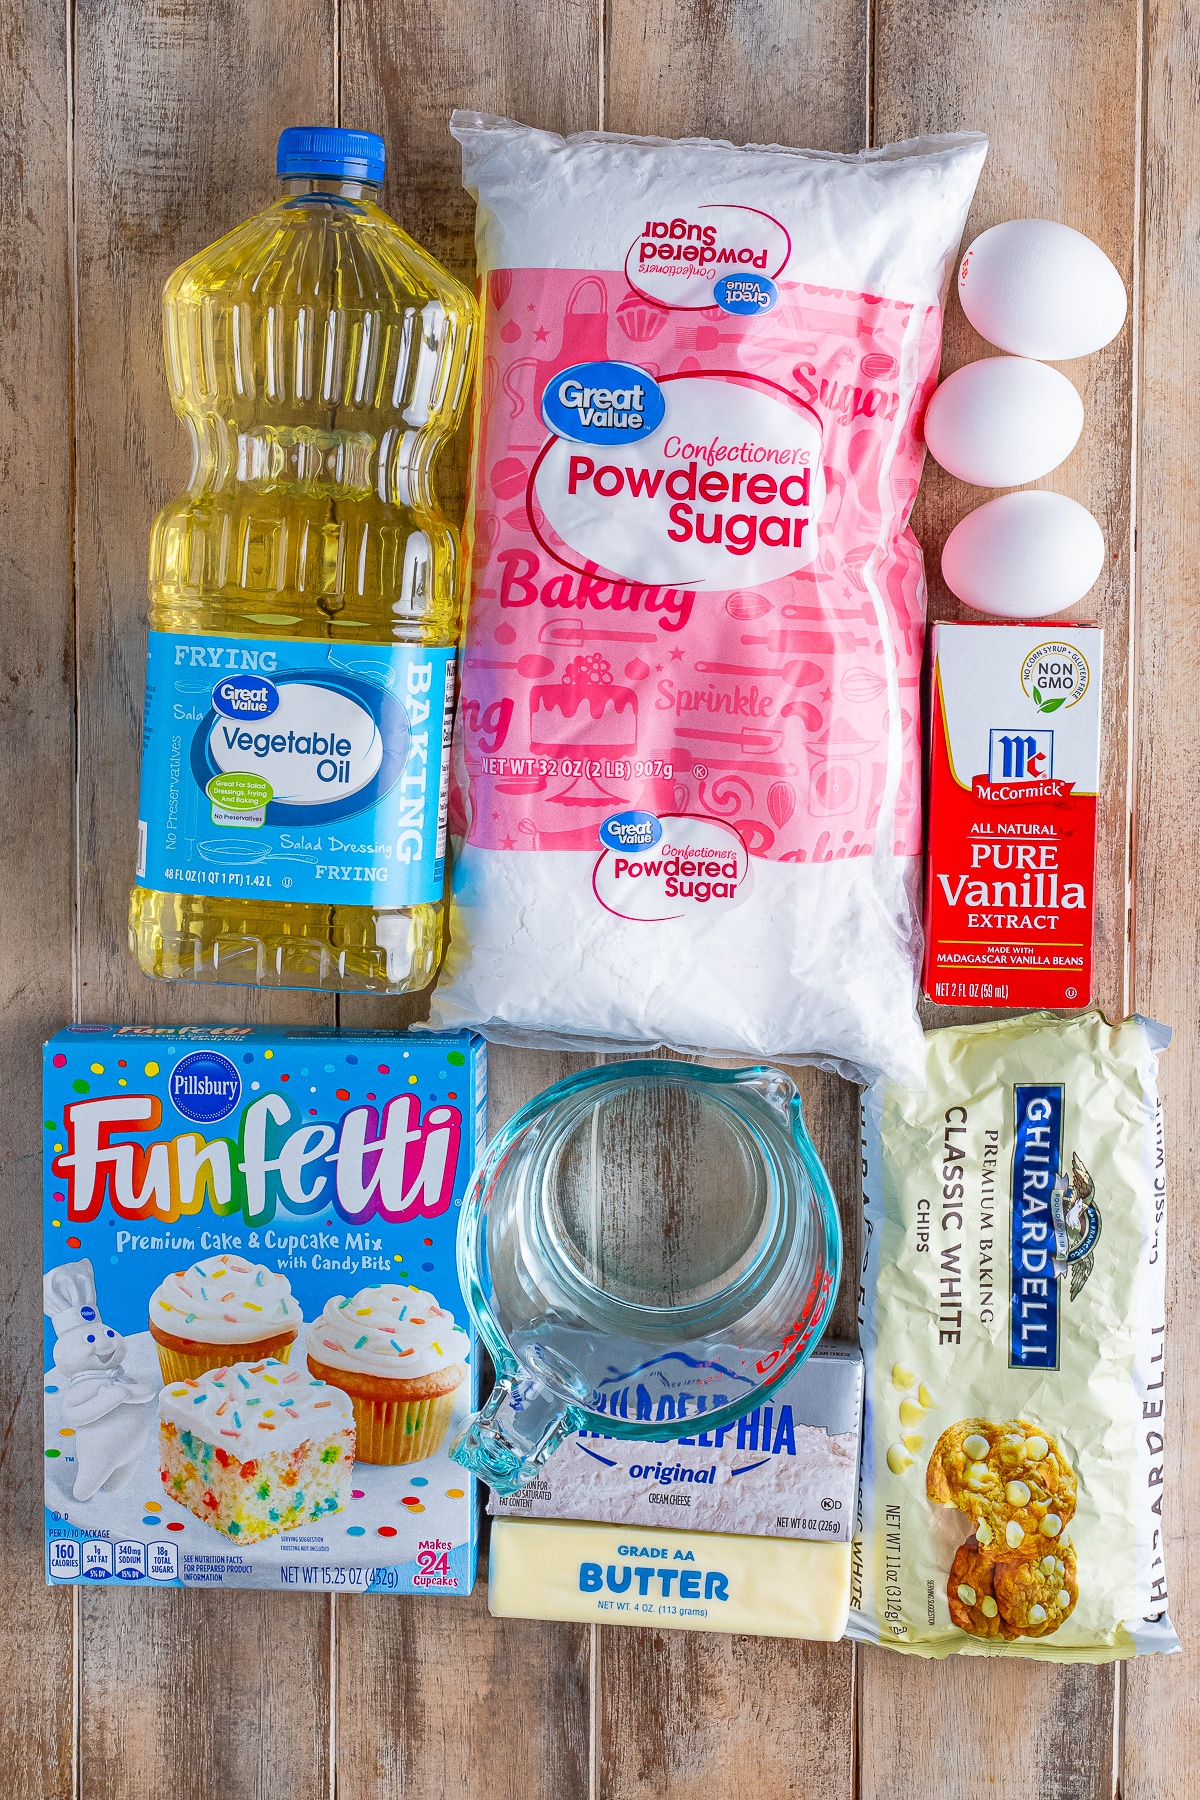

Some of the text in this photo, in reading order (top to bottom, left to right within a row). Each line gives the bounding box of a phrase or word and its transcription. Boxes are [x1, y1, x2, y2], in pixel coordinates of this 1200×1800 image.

[642, 218, 717, 246] Sugar
[640, 242, 768, 269] Powdered
[638, 264, 716, 280] Confectioners
[726, 281, 760, 293] Value
[725, 289, 771, 308] Great
[558, 379, 645, 412] Great
[787, 362, 899, 426] Sugar
[578, 406, 643, 429] Value
[663, 436, 810, 466] Confectioners
[568, 455, 810, 507] Powdered
[667, 502, 809, 556] Sugar
[497, 549, 696, 632] Baking
[174, 644, 277, 672] FRYING
[1024, 645, 1067, 680] NO CORN SYRUP
[1038, 663, 1072, 675] NON
[1071, 653, 1086, 700] GLUTEN FREE
[1037, 676, 1073, 689] GMO
[220, 684, 268, 702] Great
[655, 679, 776, 718] Sprinkle
[231, 699, 268, 712] Value
[222, 727, 351, 757] Vegetable
[317, 760, 351, 783] Oil
[397, 661, 432, 864] BAKING
[481, 757, 673, 781] NET WT 32 OZ (2 LB) 907g
[166, 735, 181, 850] No Preservatives
[236, 797, 258, 805] Baking
[247, 790, 267, 798] Frying
[976, 782, 1063, 801] McCormick
[607, 820, 652, 836] Great
[970, 823, 1057, 836] ALL NATURAL
[280, 833, 393, 858] Salad Dressing
[619, 833, 652, 845] Value
[661, 844, 737, 859] Confectioners
[970, 843, 1059, 871] PURE
[164, 868, 271, 887] 48 FL OZ (1 QT PT) 1.42 L
[315, 865, 388, 882] FRYING
[614, 857, 738, 879] Powdered
[664, 876, 738, 903] Sugar
[936, 873, 1086, 909] Vanilla
[967, 913, 1059, 930] EXTRACT
[937, 954, 1084, 966] MADAGASCAR VANILLA BEANS
[935, 982, 1009, 999] NET 2 FL OZ (59 mL)
[174, 1074, 238, 1100] Pillsbury
[52, 1091, 461, 1227] Funfetti
[916, 1199, 930, 1253] CHIPS
[938, 1106, 968, 1345] CLASSIC WHITE
[979, 1129, 999, 1324] PREMIUM BAKING
[1021, 1097, 1052, 1355] GHIRARDELLI
[117, 1230, 383, 1255] Premium Cake & Cupcake Mix
[277, 1255, 391, 1275] with Candy Bits
[629, 1462, 717, 1485] original
[509, 1498, 532, 1508] CONTENT
[522, 1490, 552, 1501] SATURATED
[648, 1493, 691, 1506] CREAM CHEESE
[776, 1517, 841, 1533] NET WT 8 OZ (226g)
[886, 1505, 900, 1529] NET
[49, 1529, 110, 1538] PER 1/10 PACKAGE
[886, 1534, 900, 1552] WT
[55, 1544, 74, 1558] 160
[94, 1545, 101, 1554] 1g
[119, 1545, 141, 1555] 340mg
[157, 1546, 167, 1556] 18g
[418, 1539, 452, 1550] Makes
[617, 1545, 695, 1561] GRADE AA
[52, 1559, 78, 1567] CALORIES
[87, 1555, 97, 1563] SAT
[118, 1556, 141, 1564] SODIUM
[183, 1555, 243, 1564] SEE NUTRITION FACTS
[417, 1551, 450, 1576] 24
[886, 1556, 901, 1581] 11oz
[183, 1573, 222, 1581] INFORMATION
[196, 1565, 225, 1573] PREPARED
[280, 1566, 398, 1588] NET WT 15.25 OZ (432g)
[850, 1541, 864, 1610] WHITE
[413, 1575, 458, 1587] Cupcakes
[579, 1562, 729, 1601] BUTTER
[598, 1600, 614, 1610] NET
[616, 1602, 631, 1611] WT.
[642, 1604, 655, 1613] OZ.
[658, 1605, 677, 1615] (113
[679, 1608, 708, 1618] grams)
[885, 1586, 901, 1622] (312g)
